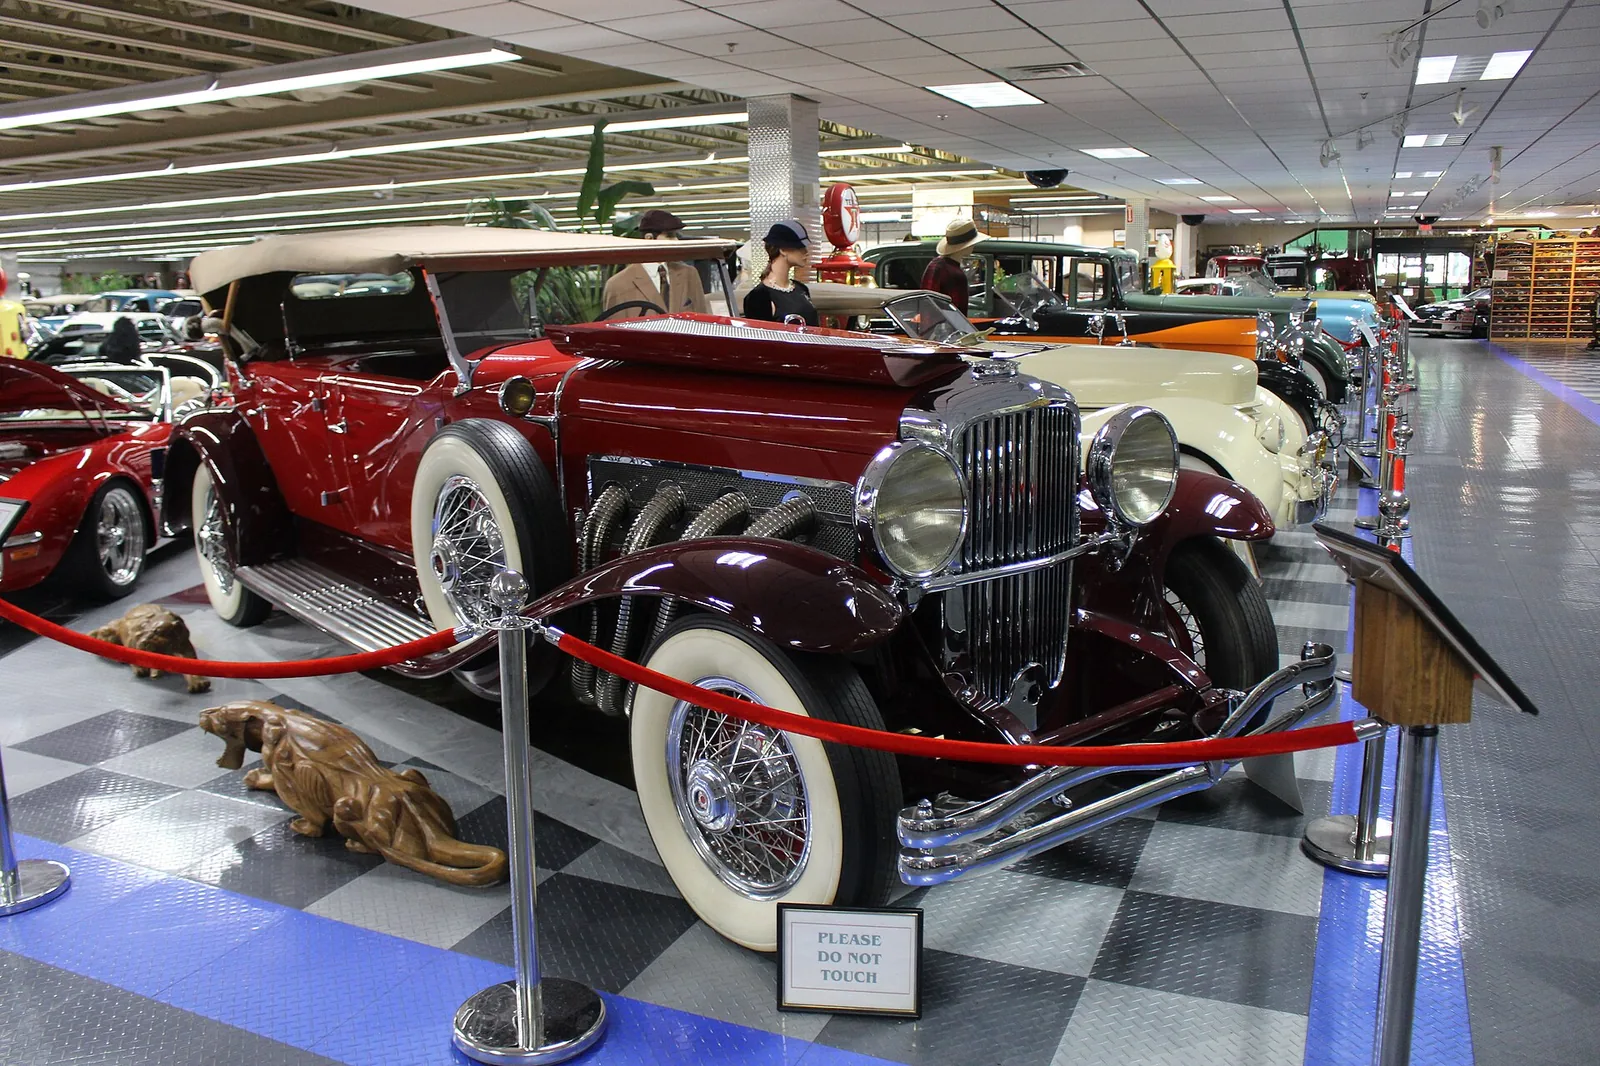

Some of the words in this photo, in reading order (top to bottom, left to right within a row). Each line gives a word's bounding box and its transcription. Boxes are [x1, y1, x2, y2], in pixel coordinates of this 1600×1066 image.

[818, 932, 882, 946] PLEASE
[818, 951, 842, 963] DO
[848, 953, 882, 965] NOT
[821, 970, 877, 983] TOUCH
